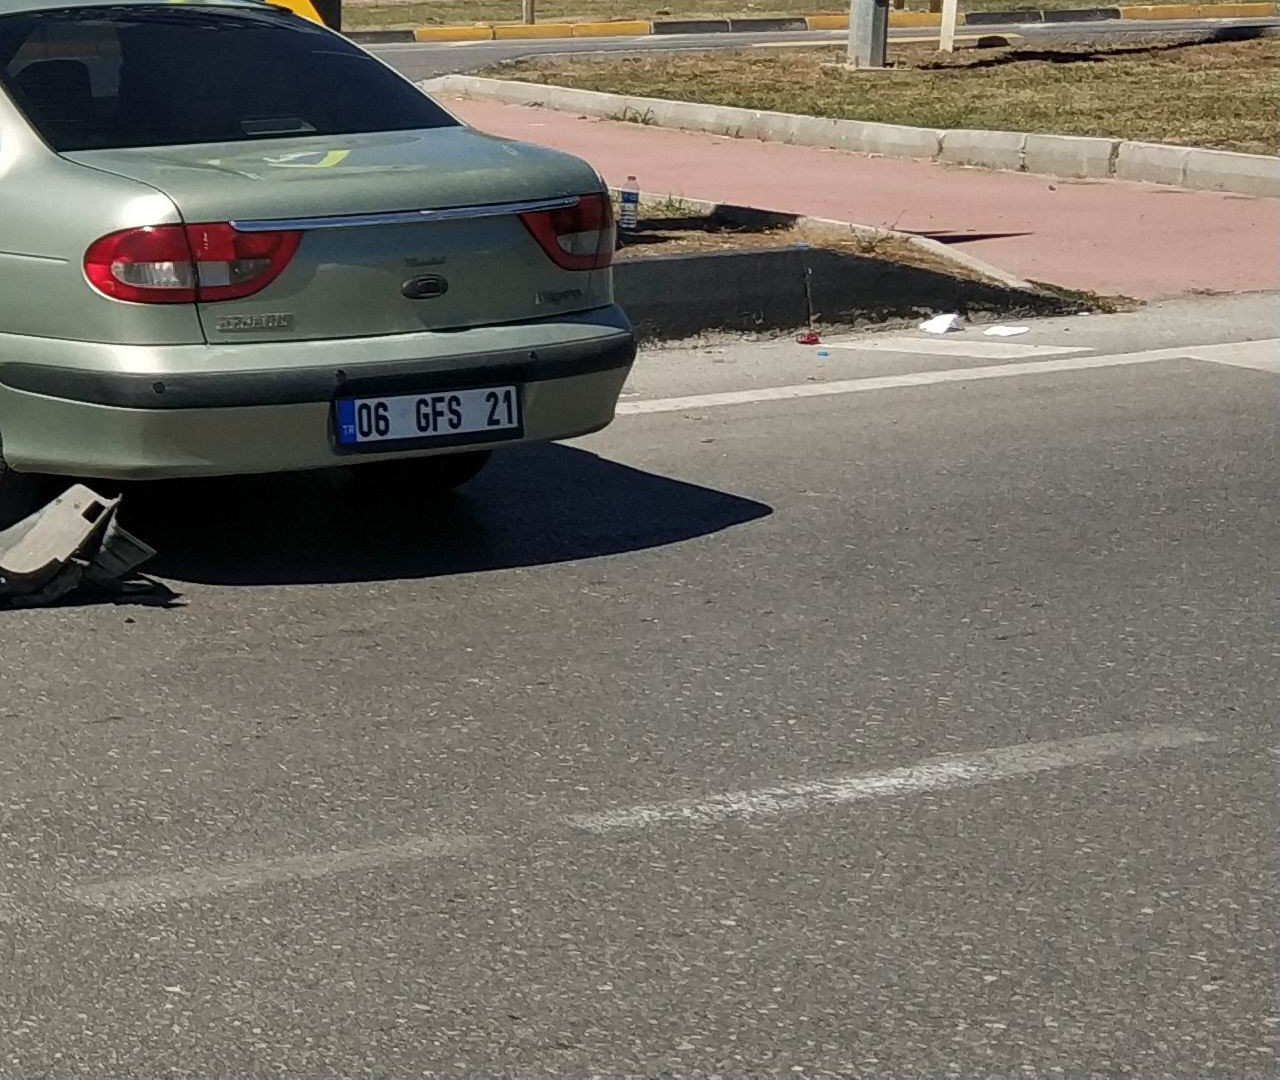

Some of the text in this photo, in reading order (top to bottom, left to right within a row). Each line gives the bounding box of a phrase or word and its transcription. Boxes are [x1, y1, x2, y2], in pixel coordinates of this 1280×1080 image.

[357, 401, 390, 438] 06
[414, 394, 463, 433] GFS
[484, 389, 514, 427] 21
